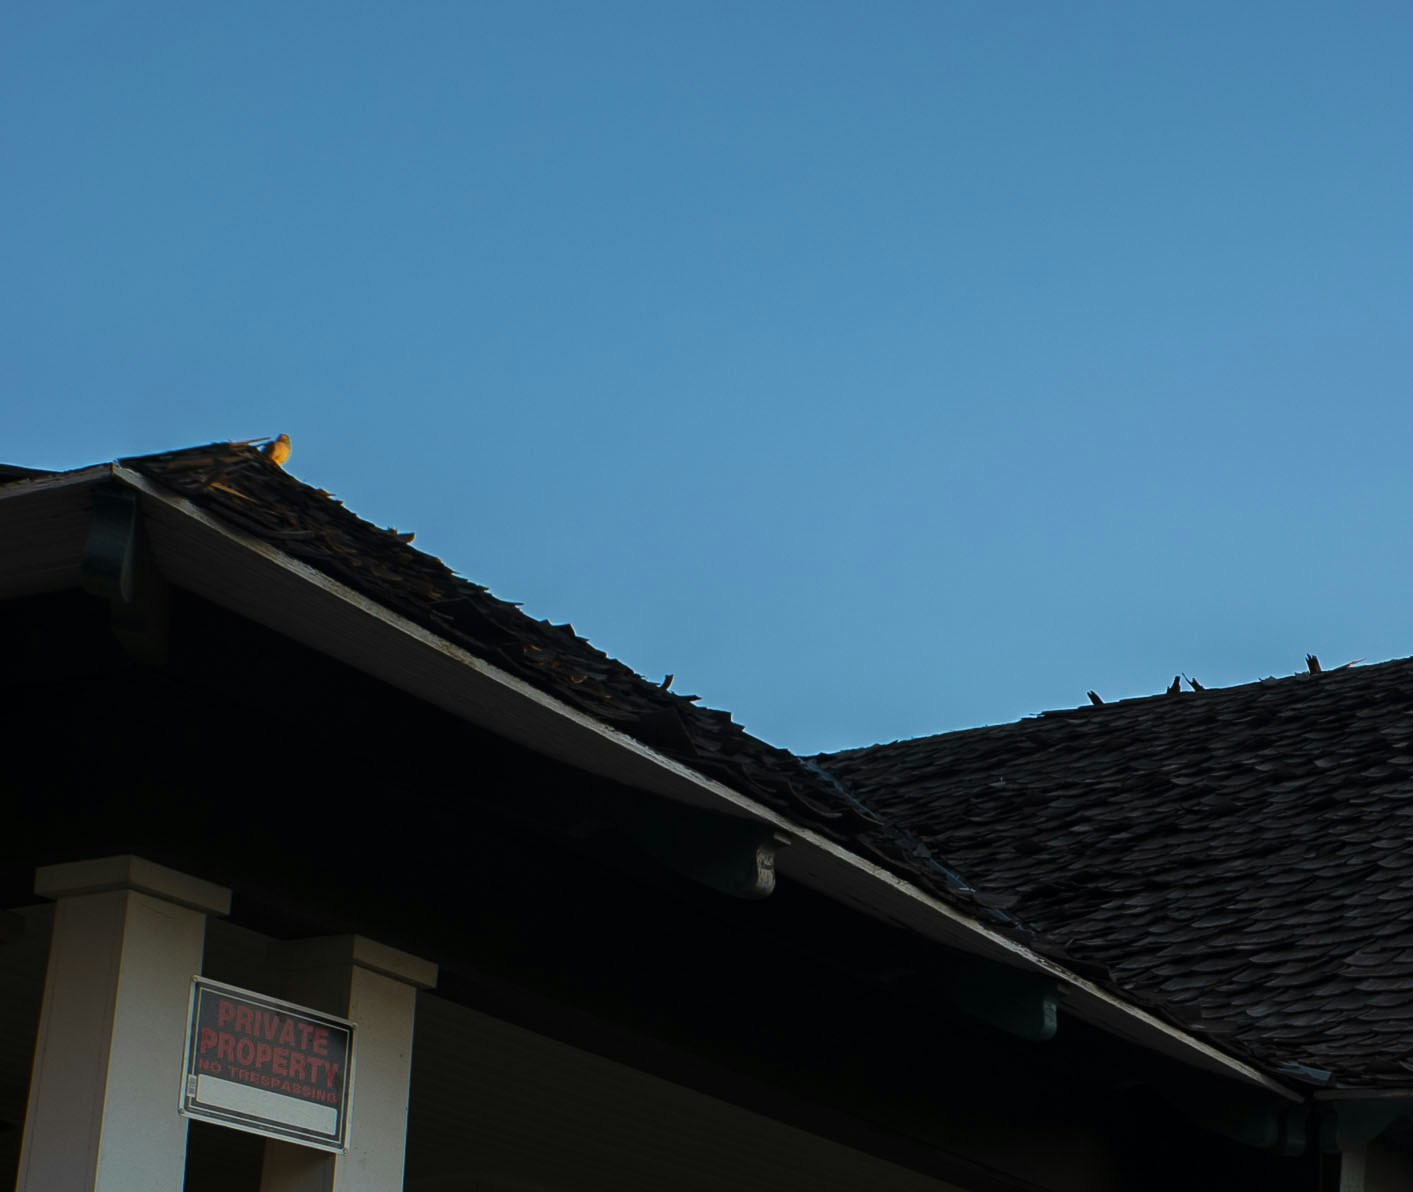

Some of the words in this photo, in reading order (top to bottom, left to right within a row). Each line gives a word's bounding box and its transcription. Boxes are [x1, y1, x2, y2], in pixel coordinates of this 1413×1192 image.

[218, 1001, 329, 1056] PRIVATE
[200, 1058, 222, 1074] NO
[230, 1066, 337, 1104] TRESPASSING
[201, 1027, 339, 1088] PROPERTY
